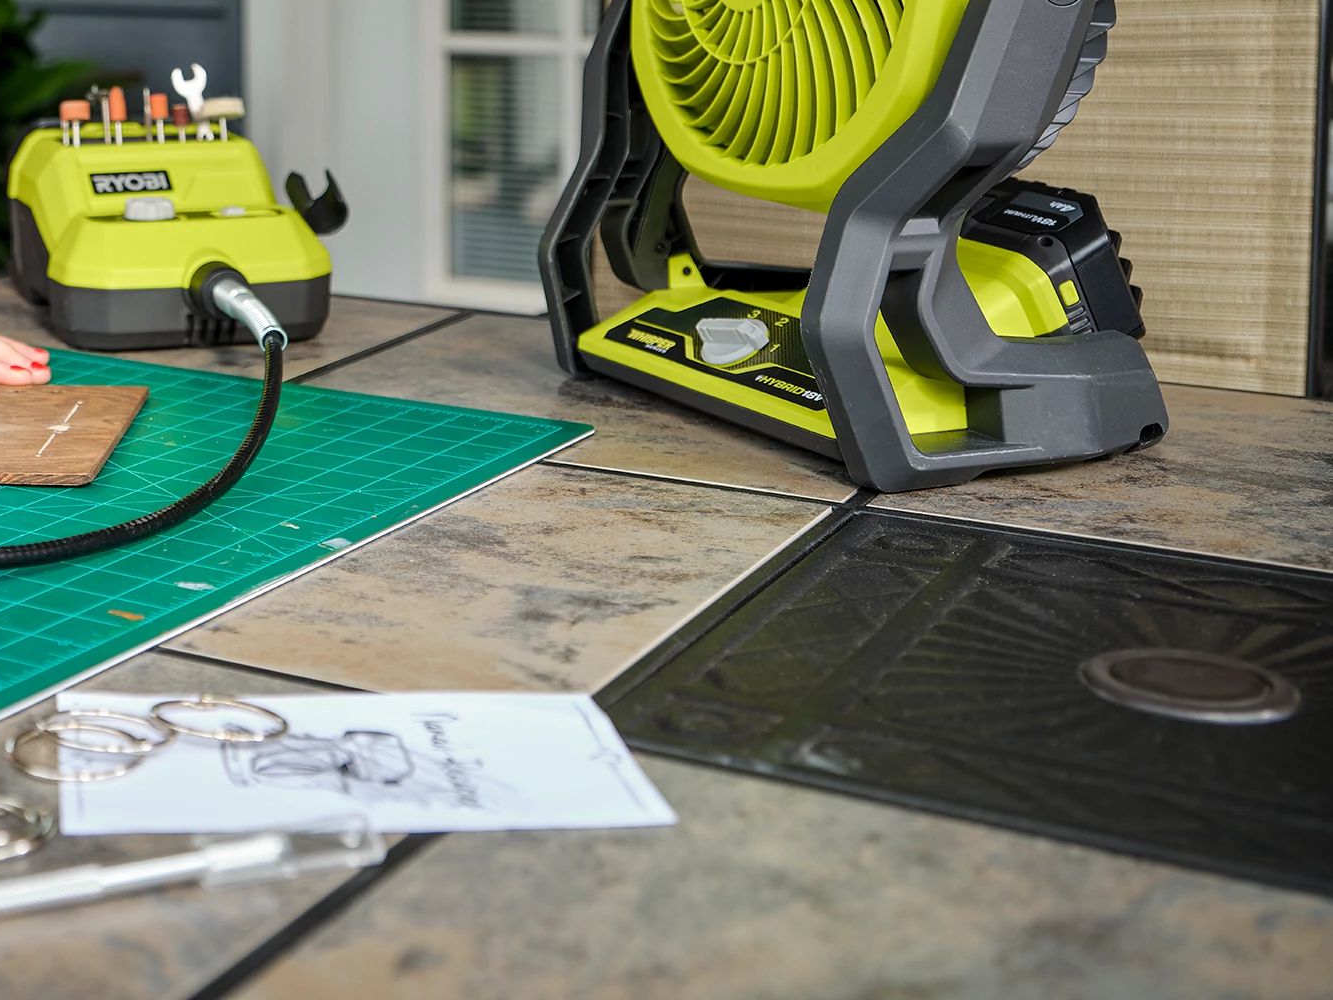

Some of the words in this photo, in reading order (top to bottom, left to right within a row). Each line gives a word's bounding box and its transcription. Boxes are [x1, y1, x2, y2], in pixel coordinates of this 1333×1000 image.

[92, 172, 169, 193] RYOBI
[747, 310, 761, 319] 3
[774, 317, 789, 327] 2
[770, 343, 781, 353] 1
